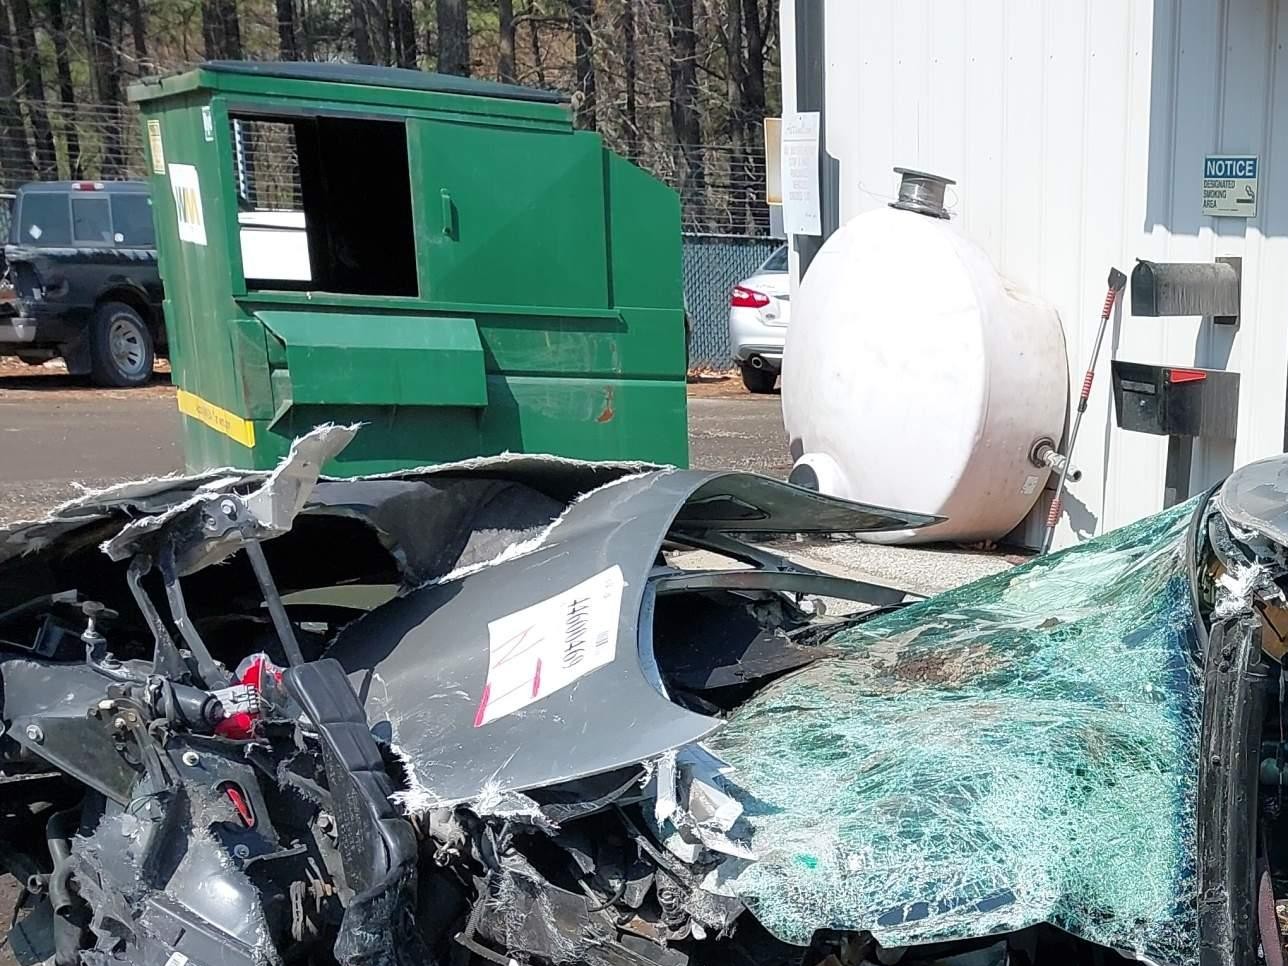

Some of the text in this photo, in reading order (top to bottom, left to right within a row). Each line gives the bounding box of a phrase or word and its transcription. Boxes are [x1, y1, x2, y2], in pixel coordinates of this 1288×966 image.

[1206, 160, 1254, 176] NOTICE
[1203, 180, 1236, 189] DESIGNATED
[1202, 189, 1227, 199] SMOKING
[1202, 199, 1217, 208] AREA
